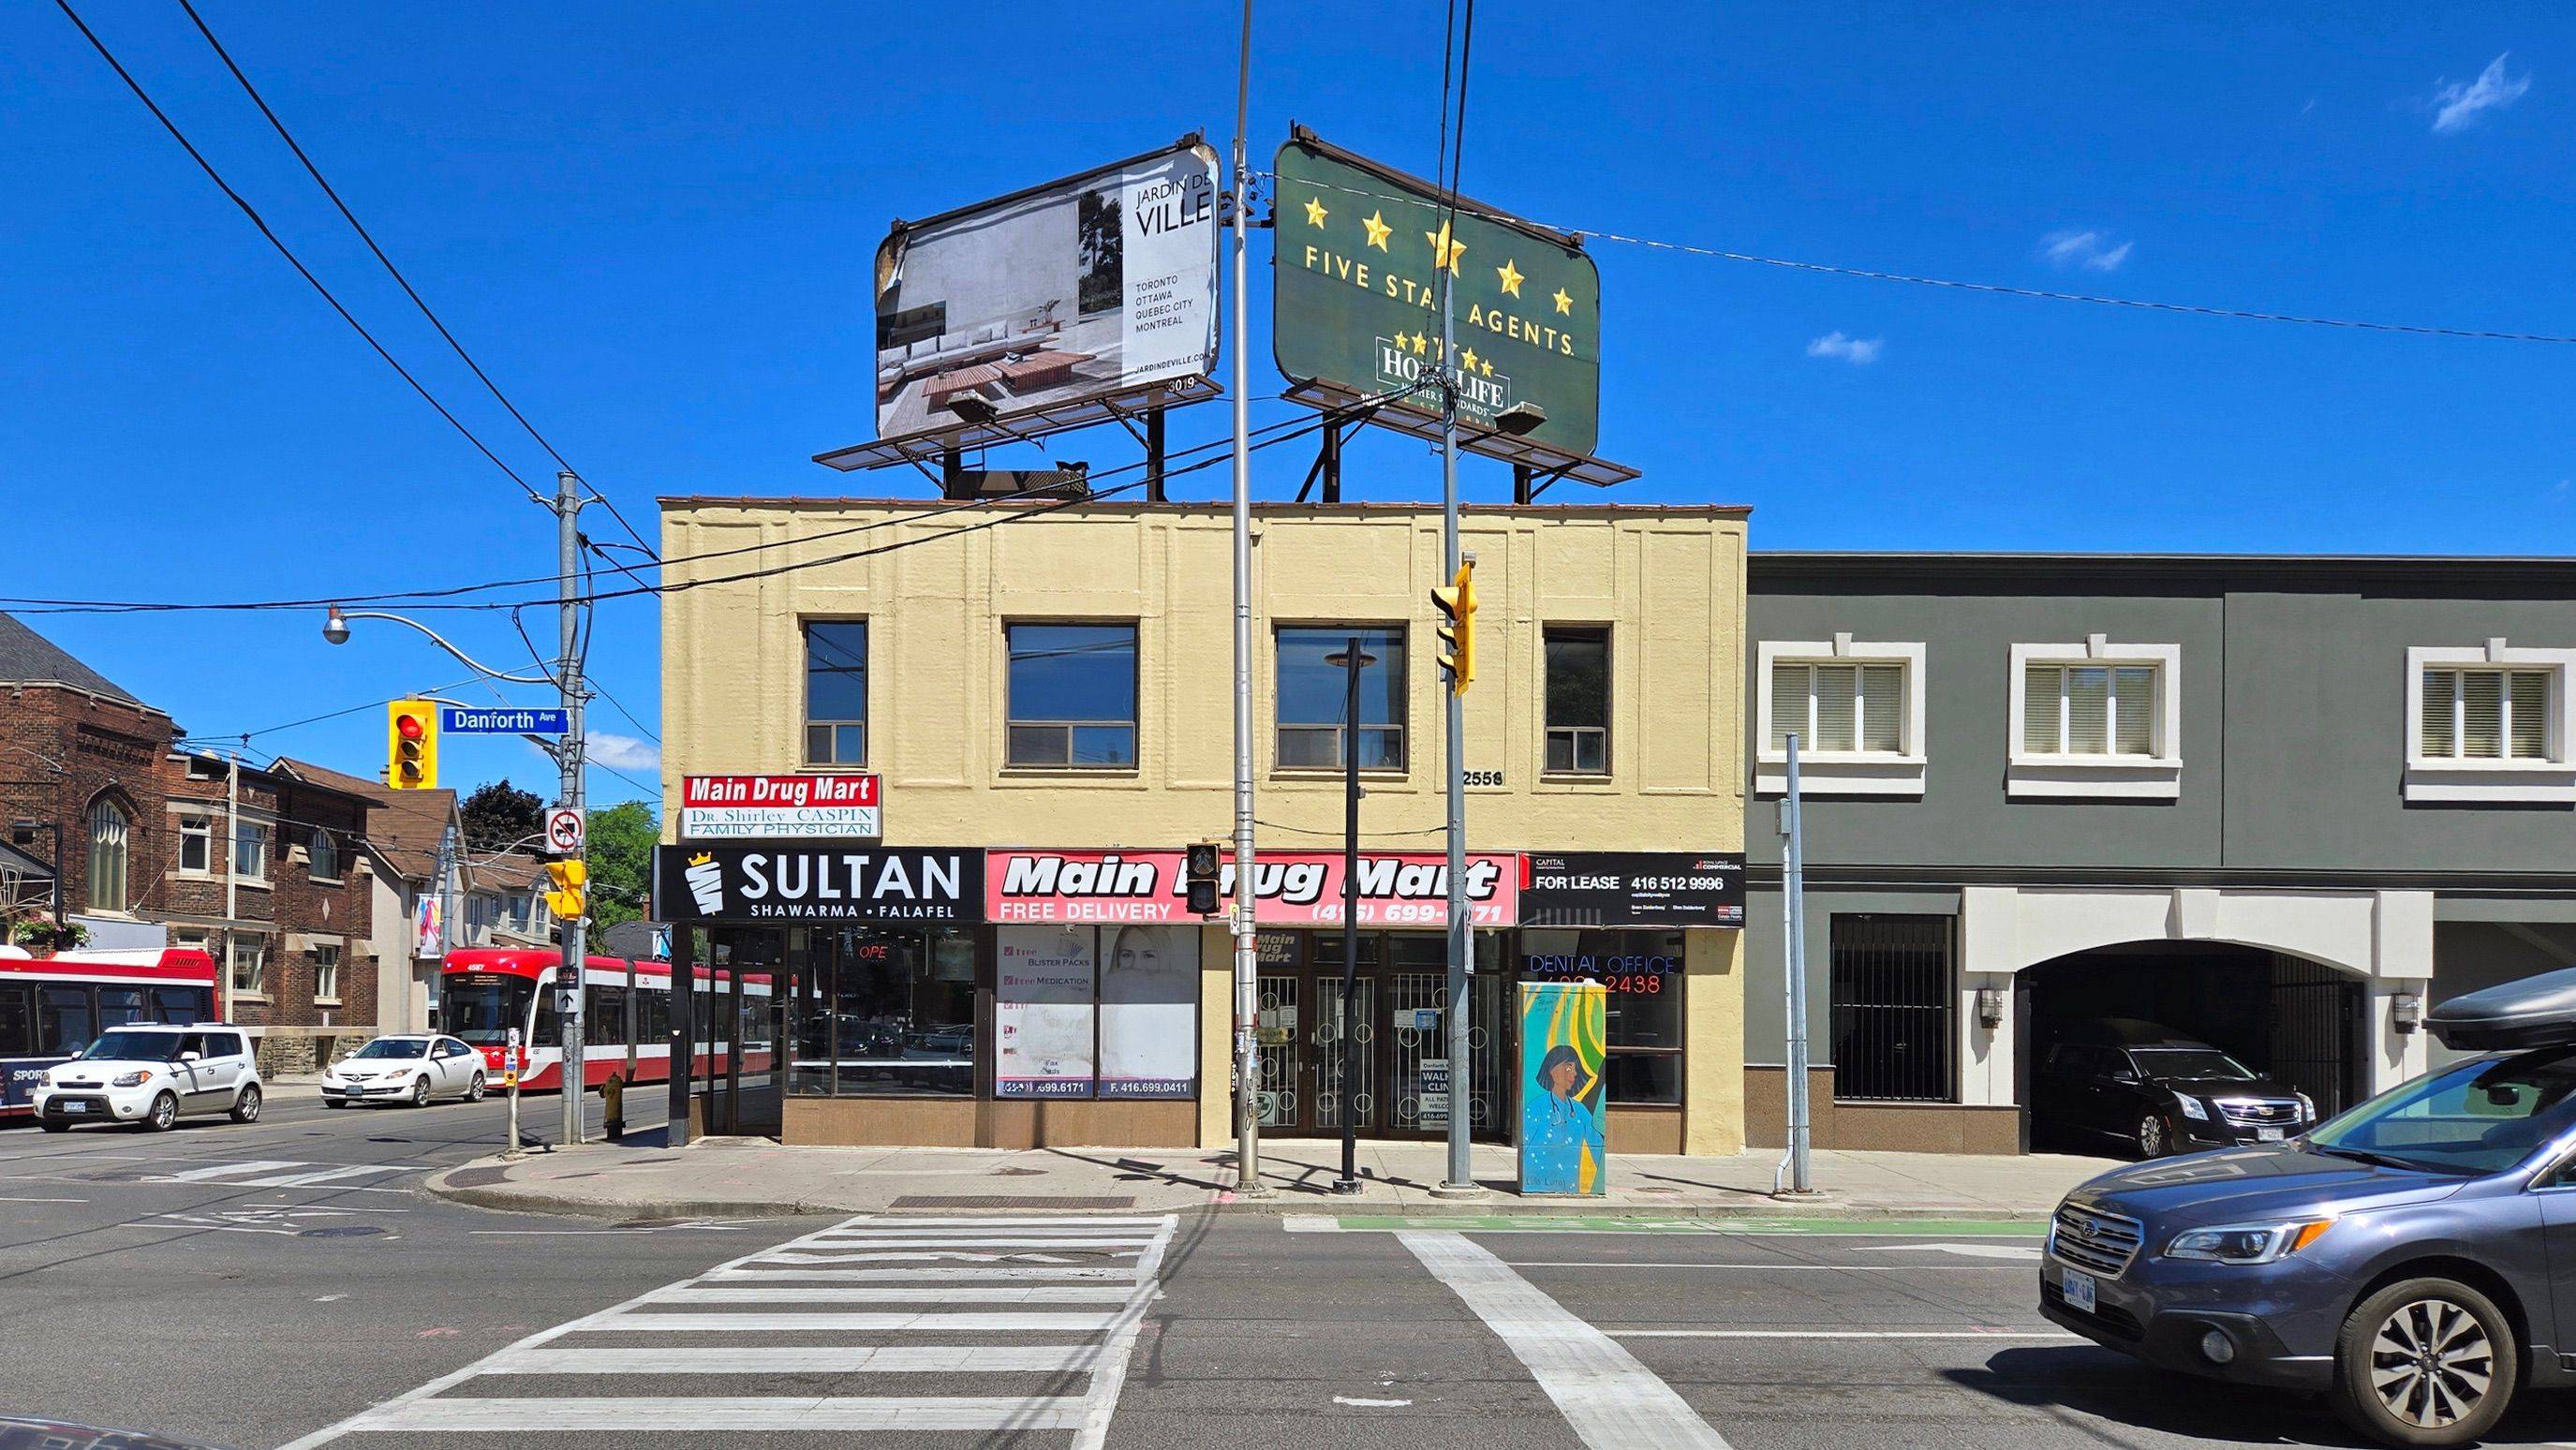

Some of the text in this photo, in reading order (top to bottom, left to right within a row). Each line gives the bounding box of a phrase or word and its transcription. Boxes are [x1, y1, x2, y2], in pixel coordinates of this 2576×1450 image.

[1136, 171, 1210, 210] JARDIN DE
[1136, 191, 1210, 237] VILLE
[1135, 274, 1178, 293] TORONTO
[1305, 245, 1369, 289] FIVE
[1385, 274, 1436, 311] STA
[1136, 290, 1173, 306] OTTAWA
[1135, 299, 1193, 320] QUEBEC CITY
[1135, 317, 1183, 333] MONTREAL
[1168, 377, 1195, 392] 3019
[1383, 347, 1504, 408] HOLIFE
[455, 711, 556, 729] Danforth Ave
[690, 777, 870, 806] Main Drug Mart
[797, 809, 872, 821] CASPIN
[690, 824, 872, 835] FAMILY PHYSICIAN
[739, 853, 960, 899] SULTAN
[1001, 855, 1158, 897] Main
[1173, 856, 1327, 905] rug
[1536, 876, 1724, 890] FOR LEASE 416 512 9996
[750, 904, 955, 918] SHAWARMA FALAFEL
[999, 903, 1055, 919] FREE
[1067, 903, 1171, 919] DELIVERY
[1384, 904, 1503, 922] 699-71
[1028, 958, 1090, 967] BLISTER PACKS
[1530, 954, 1675, 974] DENTAL OFFICE
[1606, 975, 1660, 994] 2438
[1110, 1083, 1118, 1092] F.
[1120, 1083, 1188, 1092] 416.699.0411
[1428, 1083, 1449, 1091] CLIN
